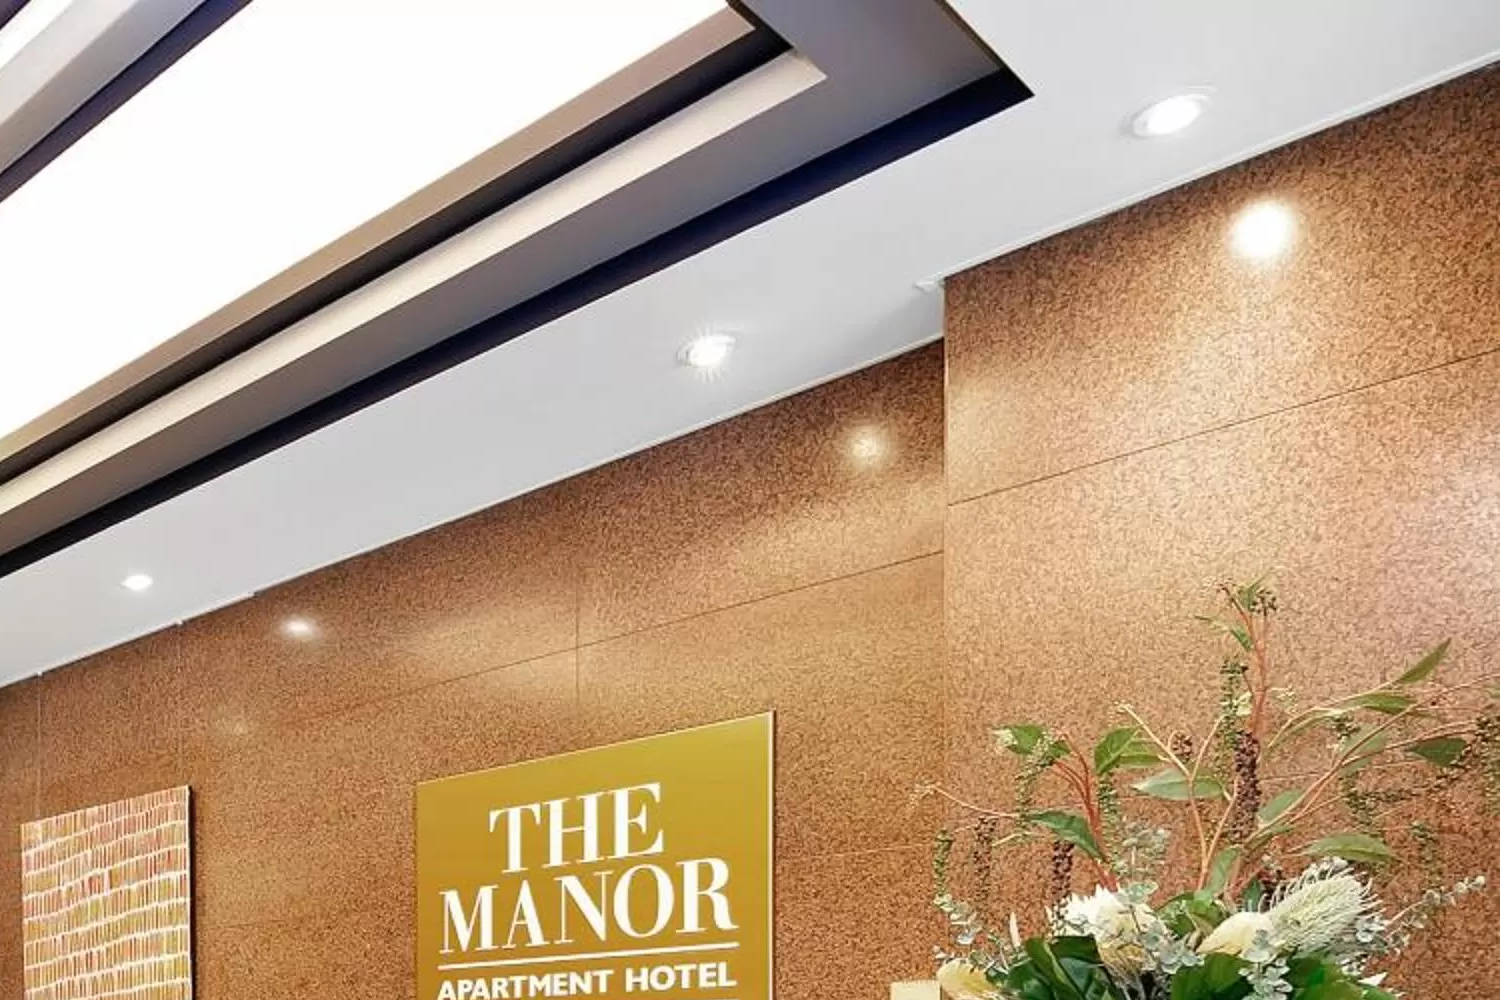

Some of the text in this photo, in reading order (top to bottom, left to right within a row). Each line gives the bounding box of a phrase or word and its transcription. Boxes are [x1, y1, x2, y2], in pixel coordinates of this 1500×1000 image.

[488, 781, 665, 873] THE
[439, 857, 740, 954] MANOR
[625, 962, 738, 992] HOTEL
